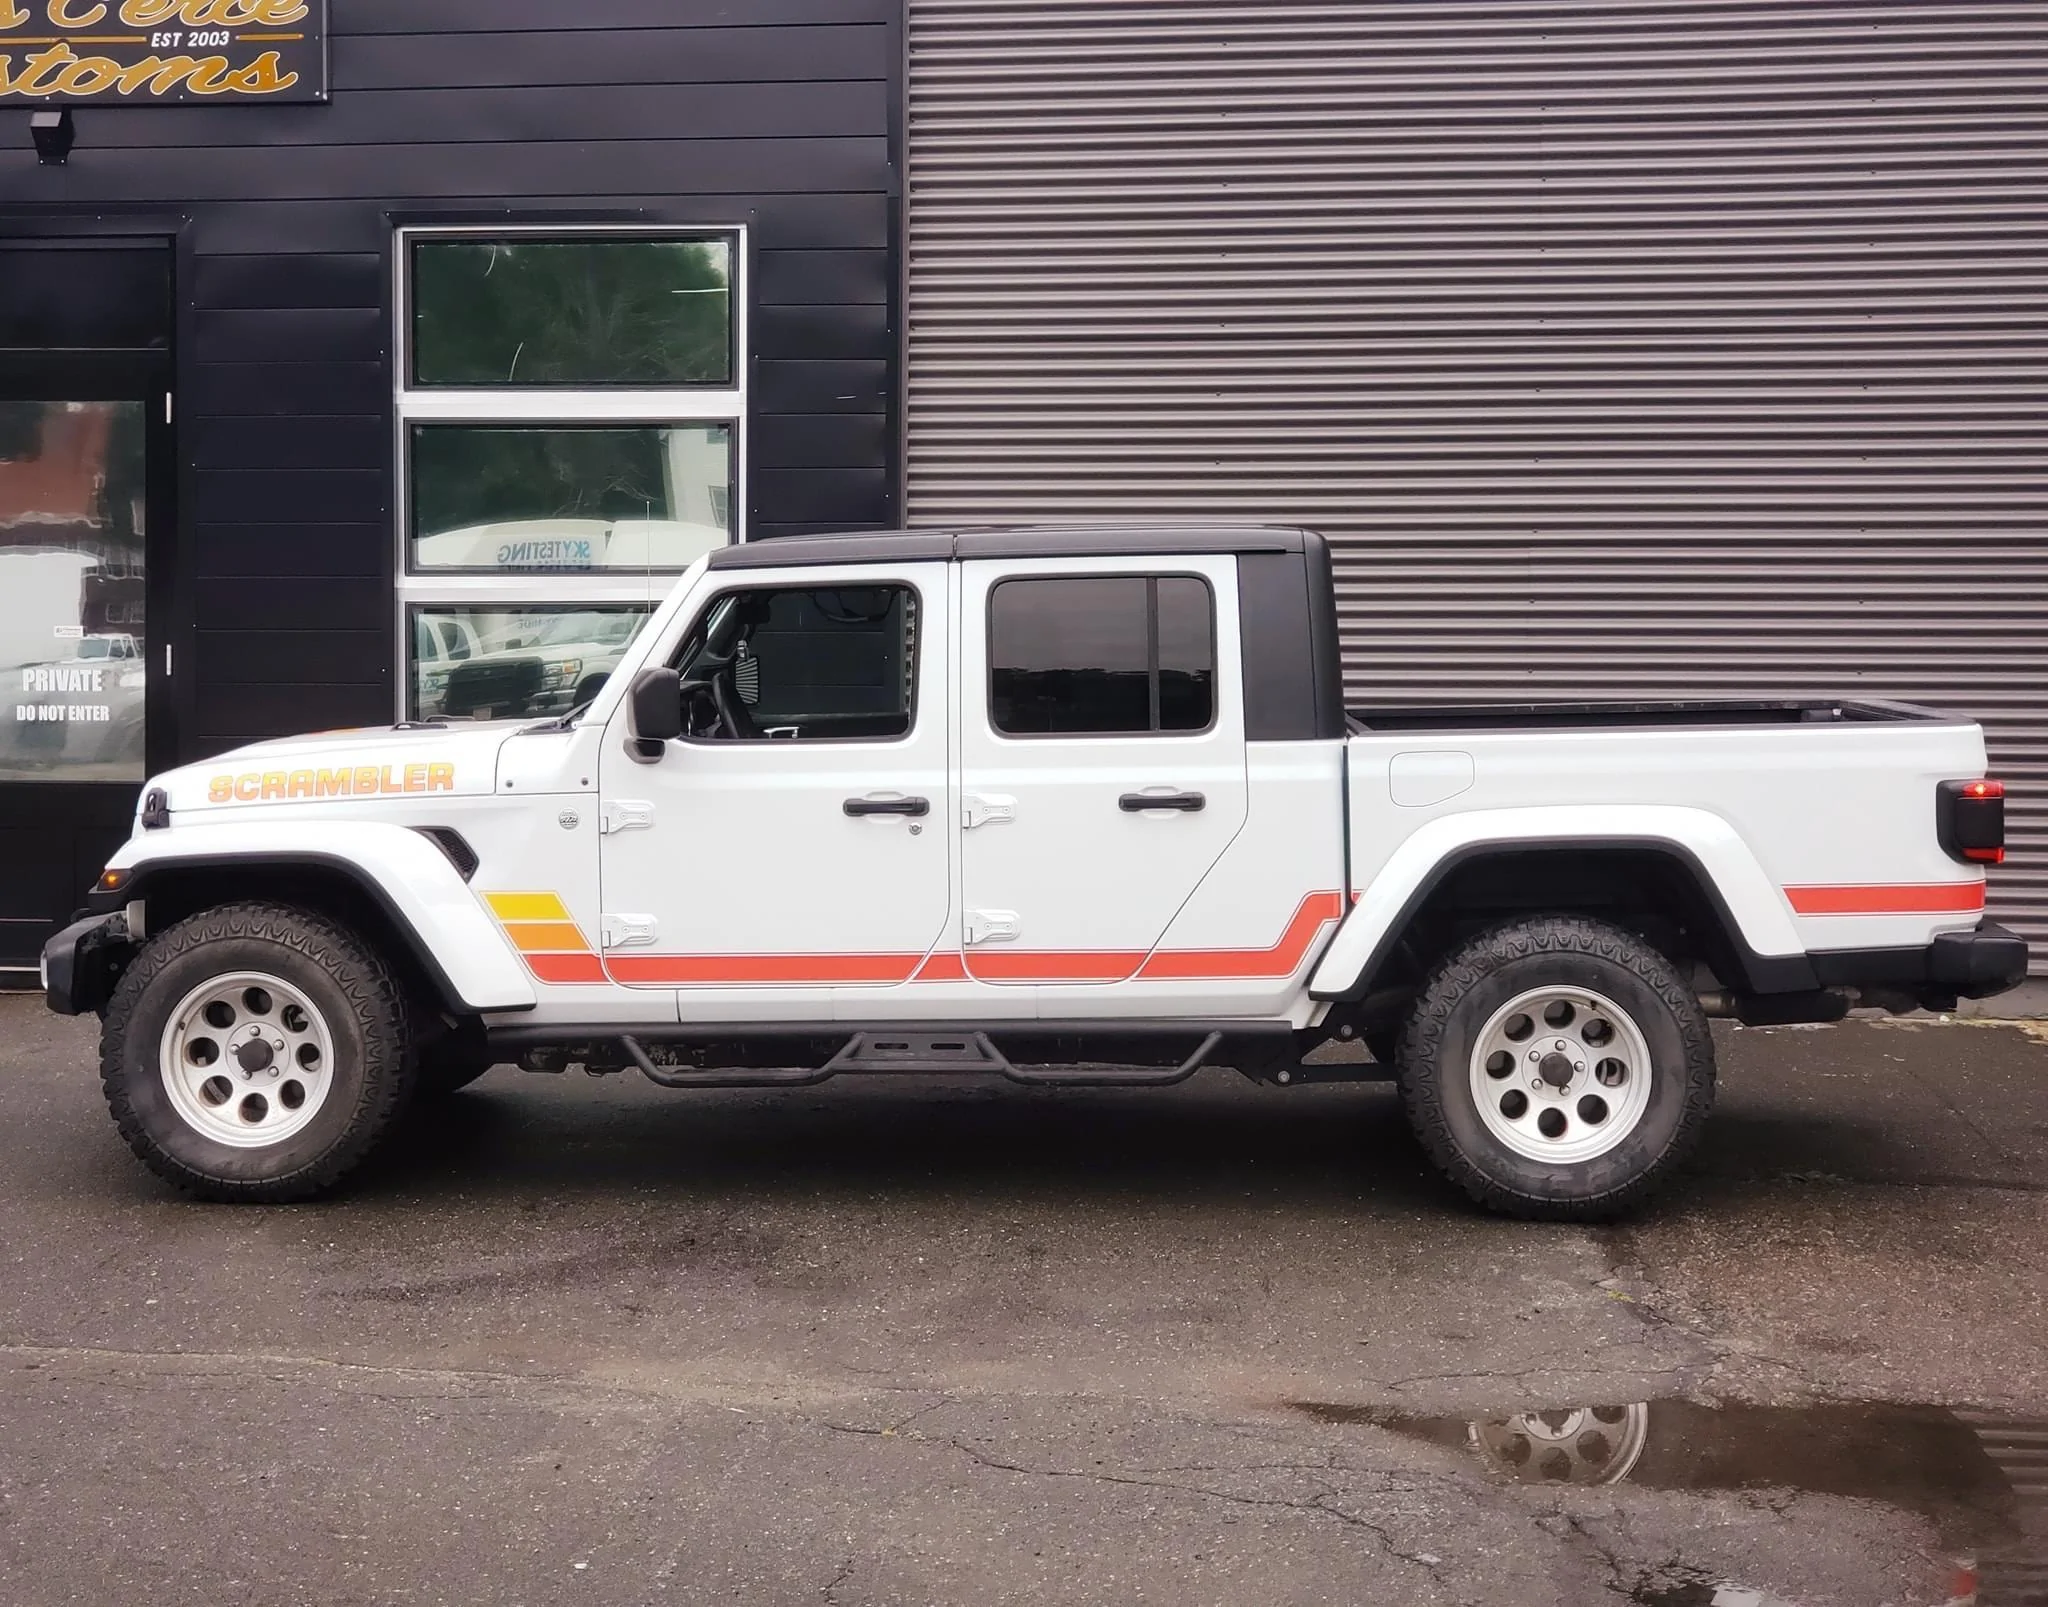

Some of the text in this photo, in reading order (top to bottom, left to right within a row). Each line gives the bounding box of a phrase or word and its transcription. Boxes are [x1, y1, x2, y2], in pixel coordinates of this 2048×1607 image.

[151, 30, 231, 48] EST 2003
[22, 669, 102, 692] PRIVATE
[16, 704, 110, 721] DO NOT ENTER
[208, 762, 455, 803] SCRAMBLER
